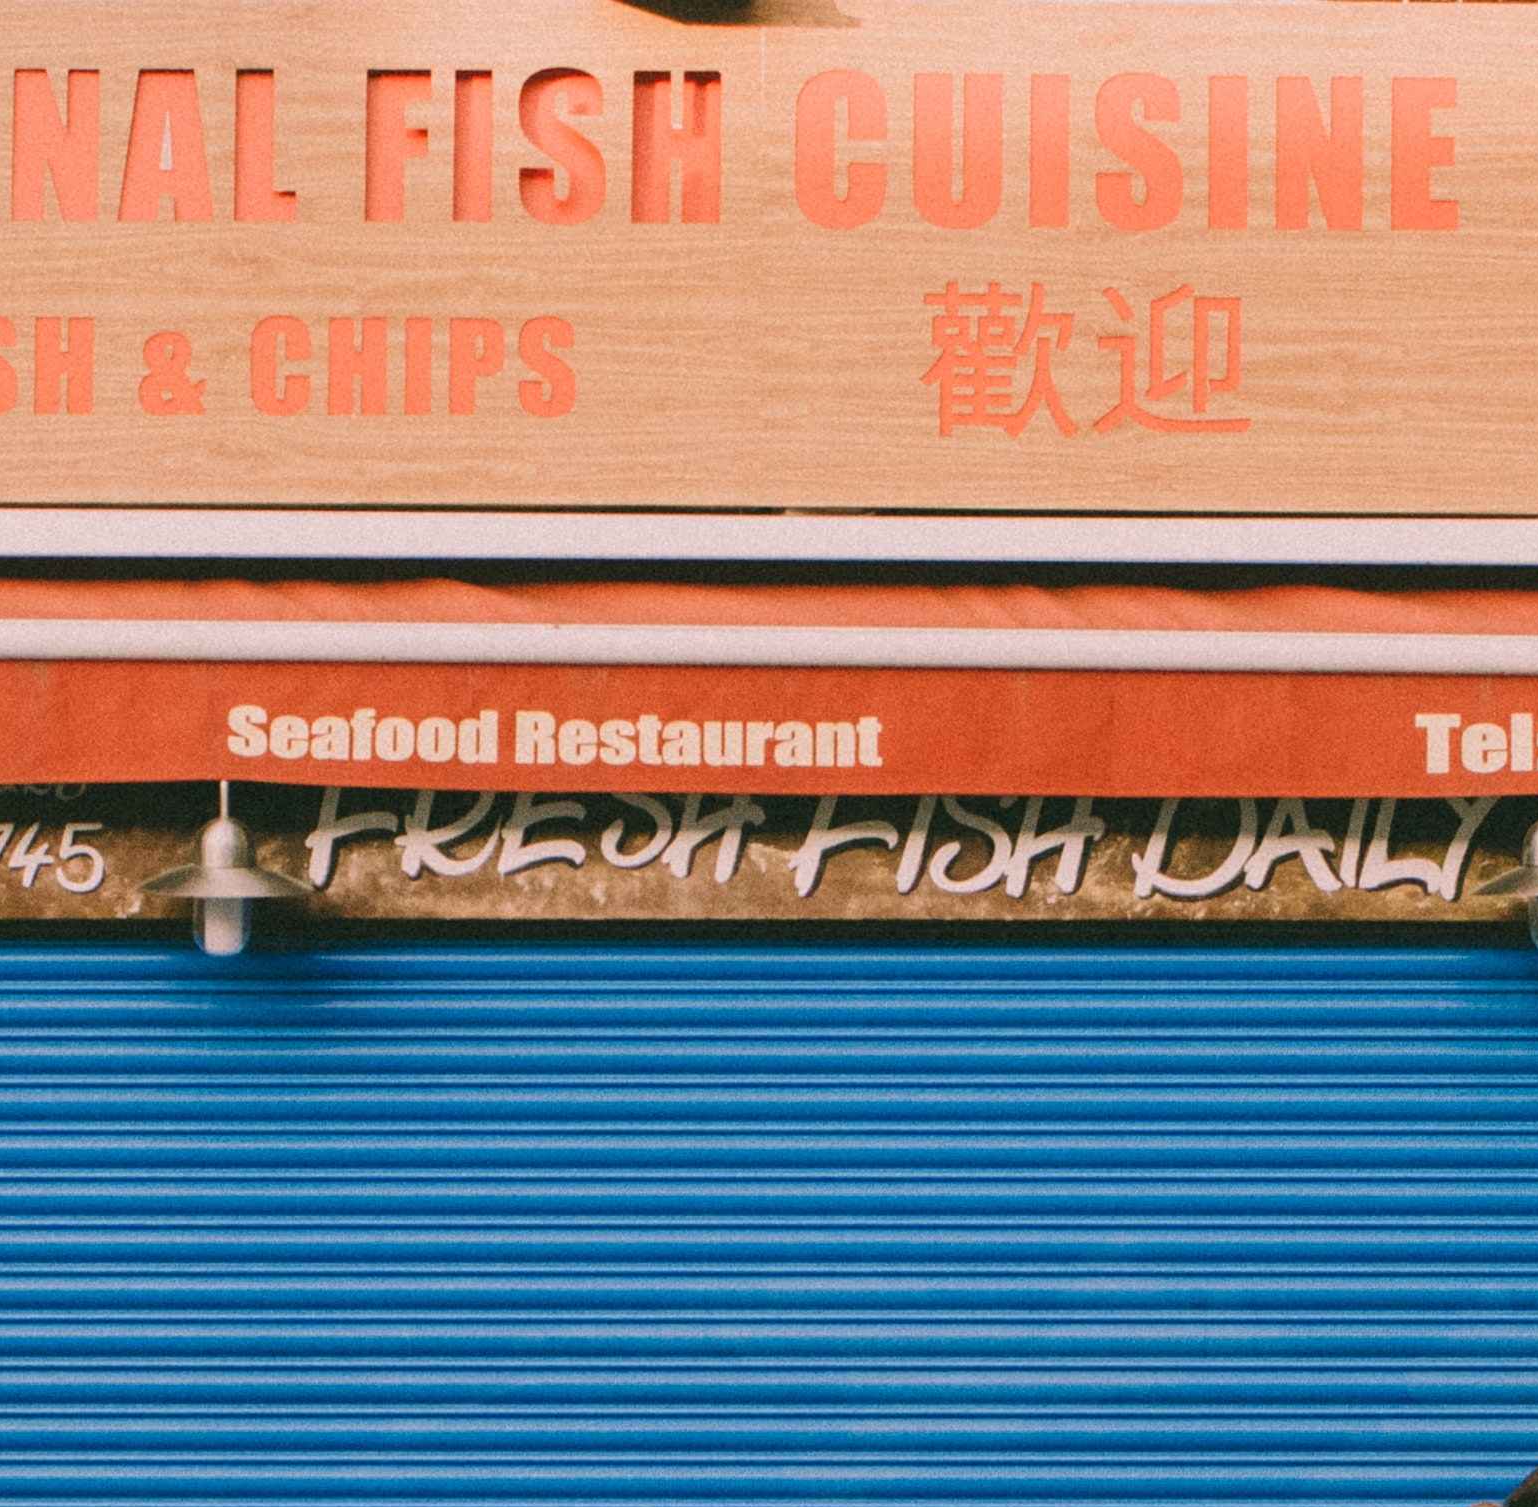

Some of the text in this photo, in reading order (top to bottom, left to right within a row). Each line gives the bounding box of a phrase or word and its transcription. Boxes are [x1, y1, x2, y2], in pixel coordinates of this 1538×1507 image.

[364, 66, 723, 227] FISH
[794, 69, 1460, 234] CUISINE
[138, 331, 207, 417] &
[249, 314, 577, 418] CHIPS
[921, 281, 1251, 438] 歡迎
[228, 705, 882, 767] Seafood Restaurant
[306, 787, 1501, 900] FRESH FISH DAILY
